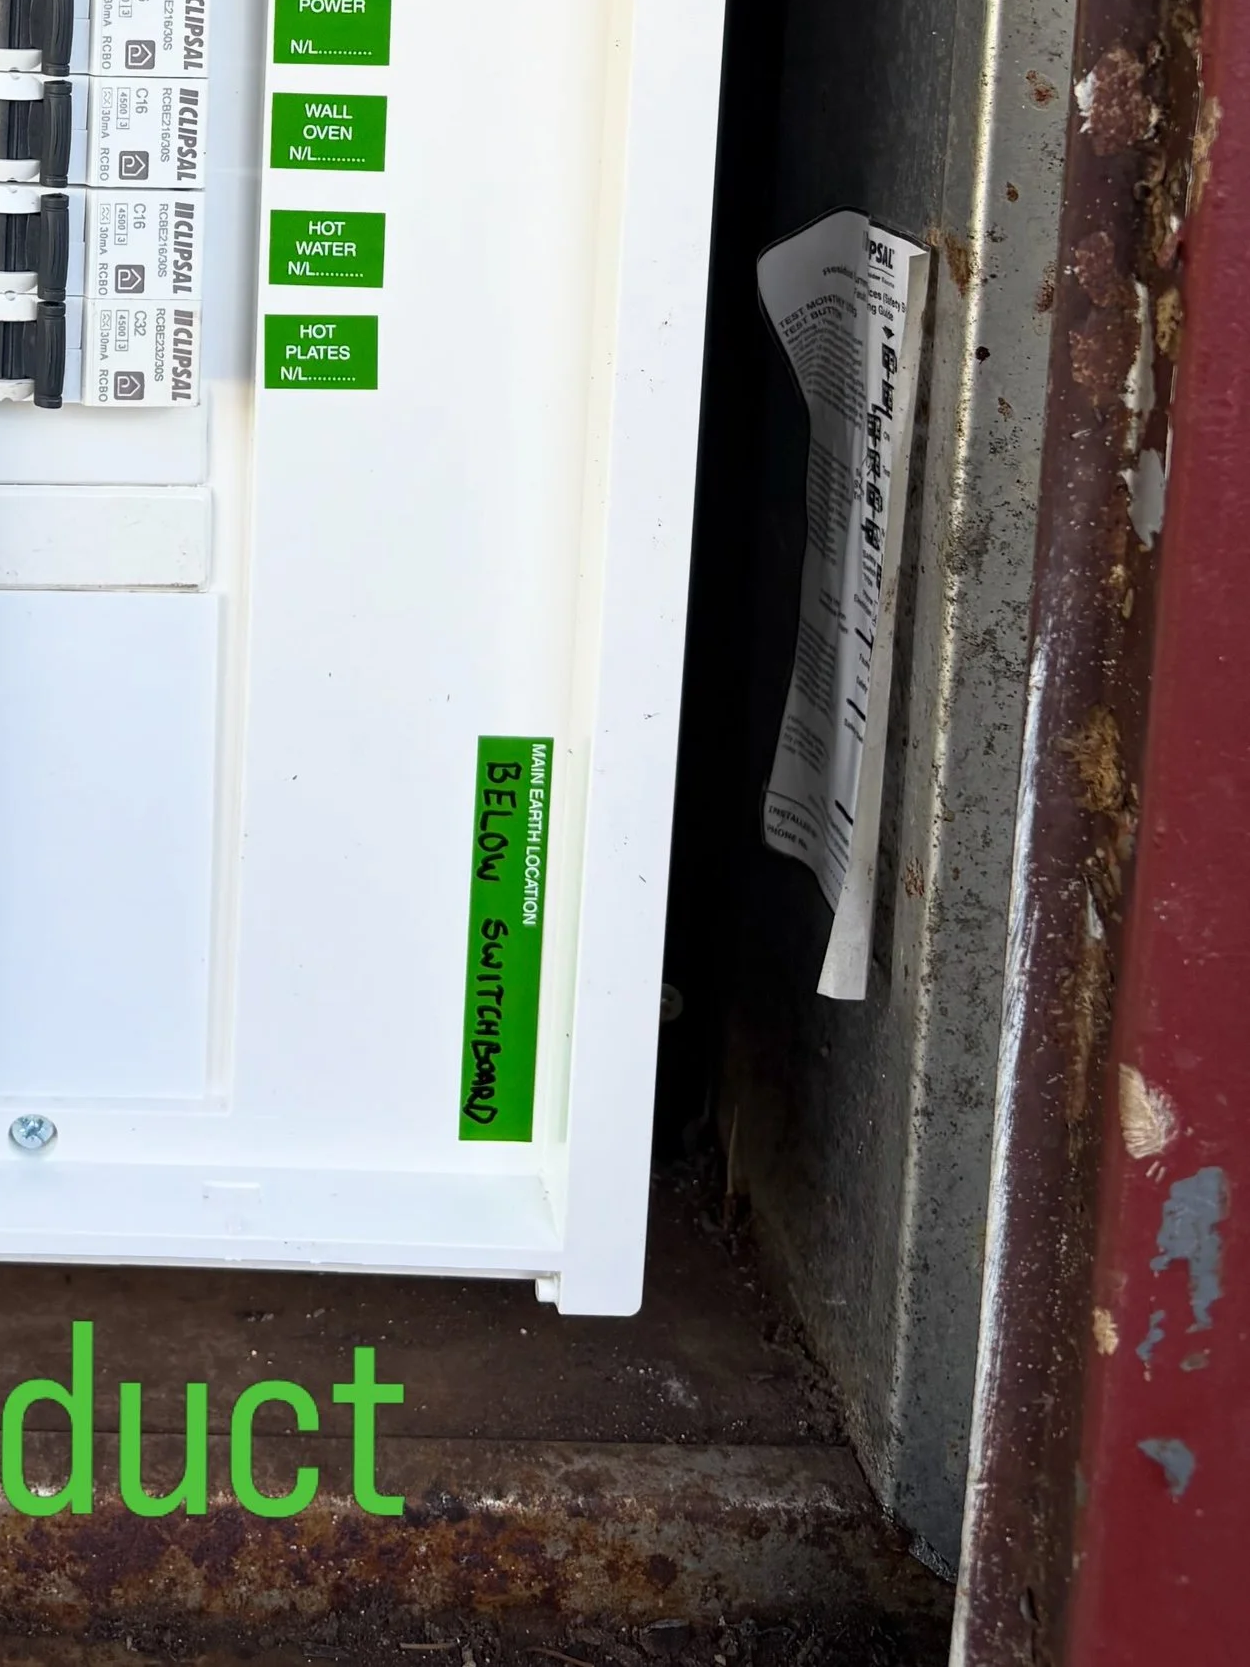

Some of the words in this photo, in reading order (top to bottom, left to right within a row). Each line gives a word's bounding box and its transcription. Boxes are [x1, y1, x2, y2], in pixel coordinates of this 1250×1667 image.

[102, 36, 112, 70] RCBO
[119, 91, 127, 115] 4500
[135, 88, 148, 114] C16
[305, 103, 353, 119] WALL
[100, 110, 111, 139] 30mA
[160, 87, 172, 162] RCBE216/30S
[302, 125, 353, 140] OVEN
[177, 107, 198, 181] CLIPSAL
[99, 147, 110, 181] RCBO
[117, 208, 126, 230] 4500
[133, 203, 145, 229] C16
[308, 221, 346, 236] HOT
[98, 227, 109, 255] 30mA
[158, 203, 168, 277] RCBE216/30S
[295, 241, 357, 257] WATER
[172, 220, 193, 294] CLIPSAL
[98, 262, 108, 295] RCBO
[117, 315, 126, 337] 4500
[134, 310, 146, 336] C32
[300, 324, 337, 339] HOT
[779, 307, 804, 328] TEST
[782, 315, 808, 338] TEST
[99, 332, 110, 361] 30mA
[154, 308, 166, 381] RCBE232/30S
[285, 345, 351, 360] PLATES
[171, 327, 192, 401] CLIPSAL
[98, 369, 109, 402] RCBO
[530, 744, 546, 784] MAIN
[476, 761, 522, 881] BELOW
[527, 789, 544, 841] EARTH
[522, 846, 540, 925] LOCATION
